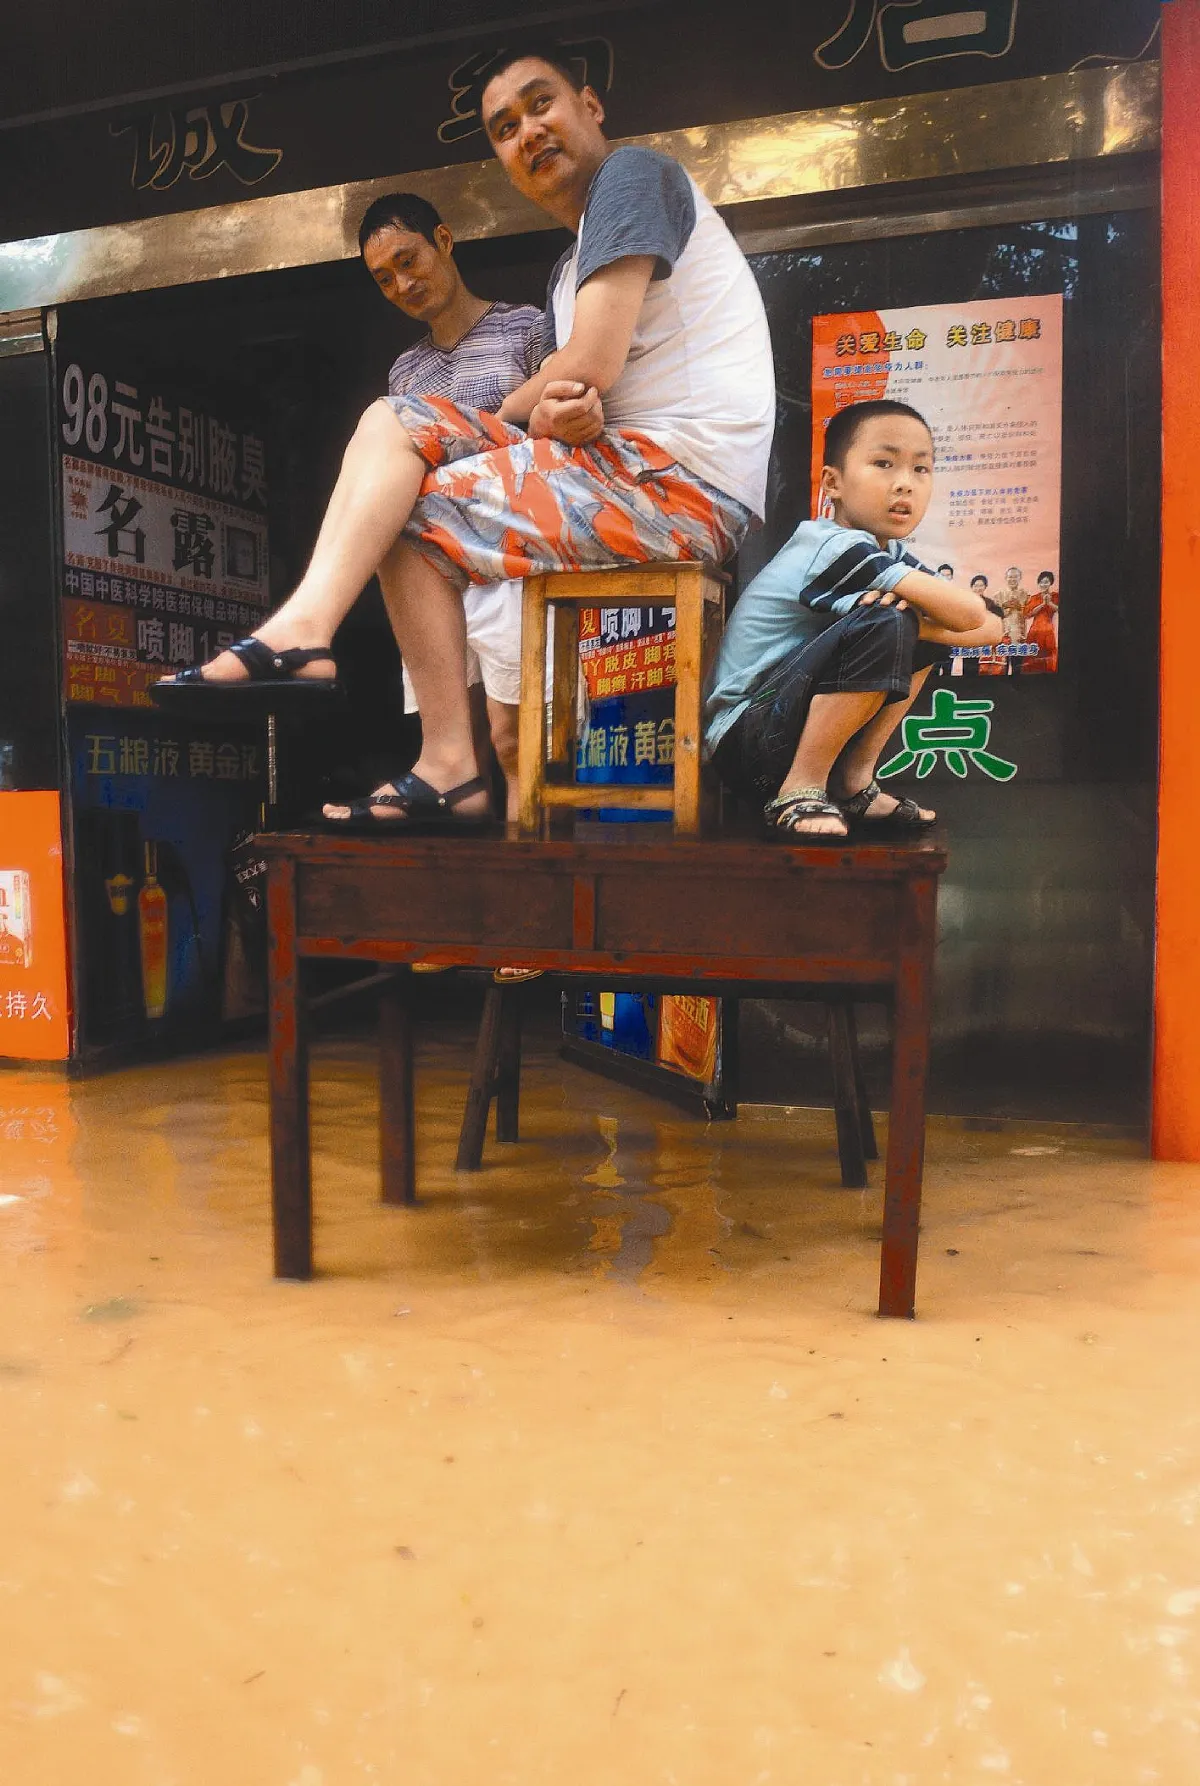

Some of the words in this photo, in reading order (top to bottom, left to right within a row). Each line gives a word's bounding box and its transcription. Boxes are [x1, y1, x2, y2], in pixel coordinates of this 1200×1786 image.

[835, 327, 928, 358] 关爱生命
[945, 317, 1042, 349] 关注健康
[61, 363, 269, 507] 98元告别腋臭
[93, 483, 216, 580] 名露
[71, 602, 131, 646] 名夏
[604, 650, 638, 675] 脱皮
[84, 733, 180, 778] 五粮液
[875, 688, 1018, 783] 点
[0, 989, 53, 1022] 持久
